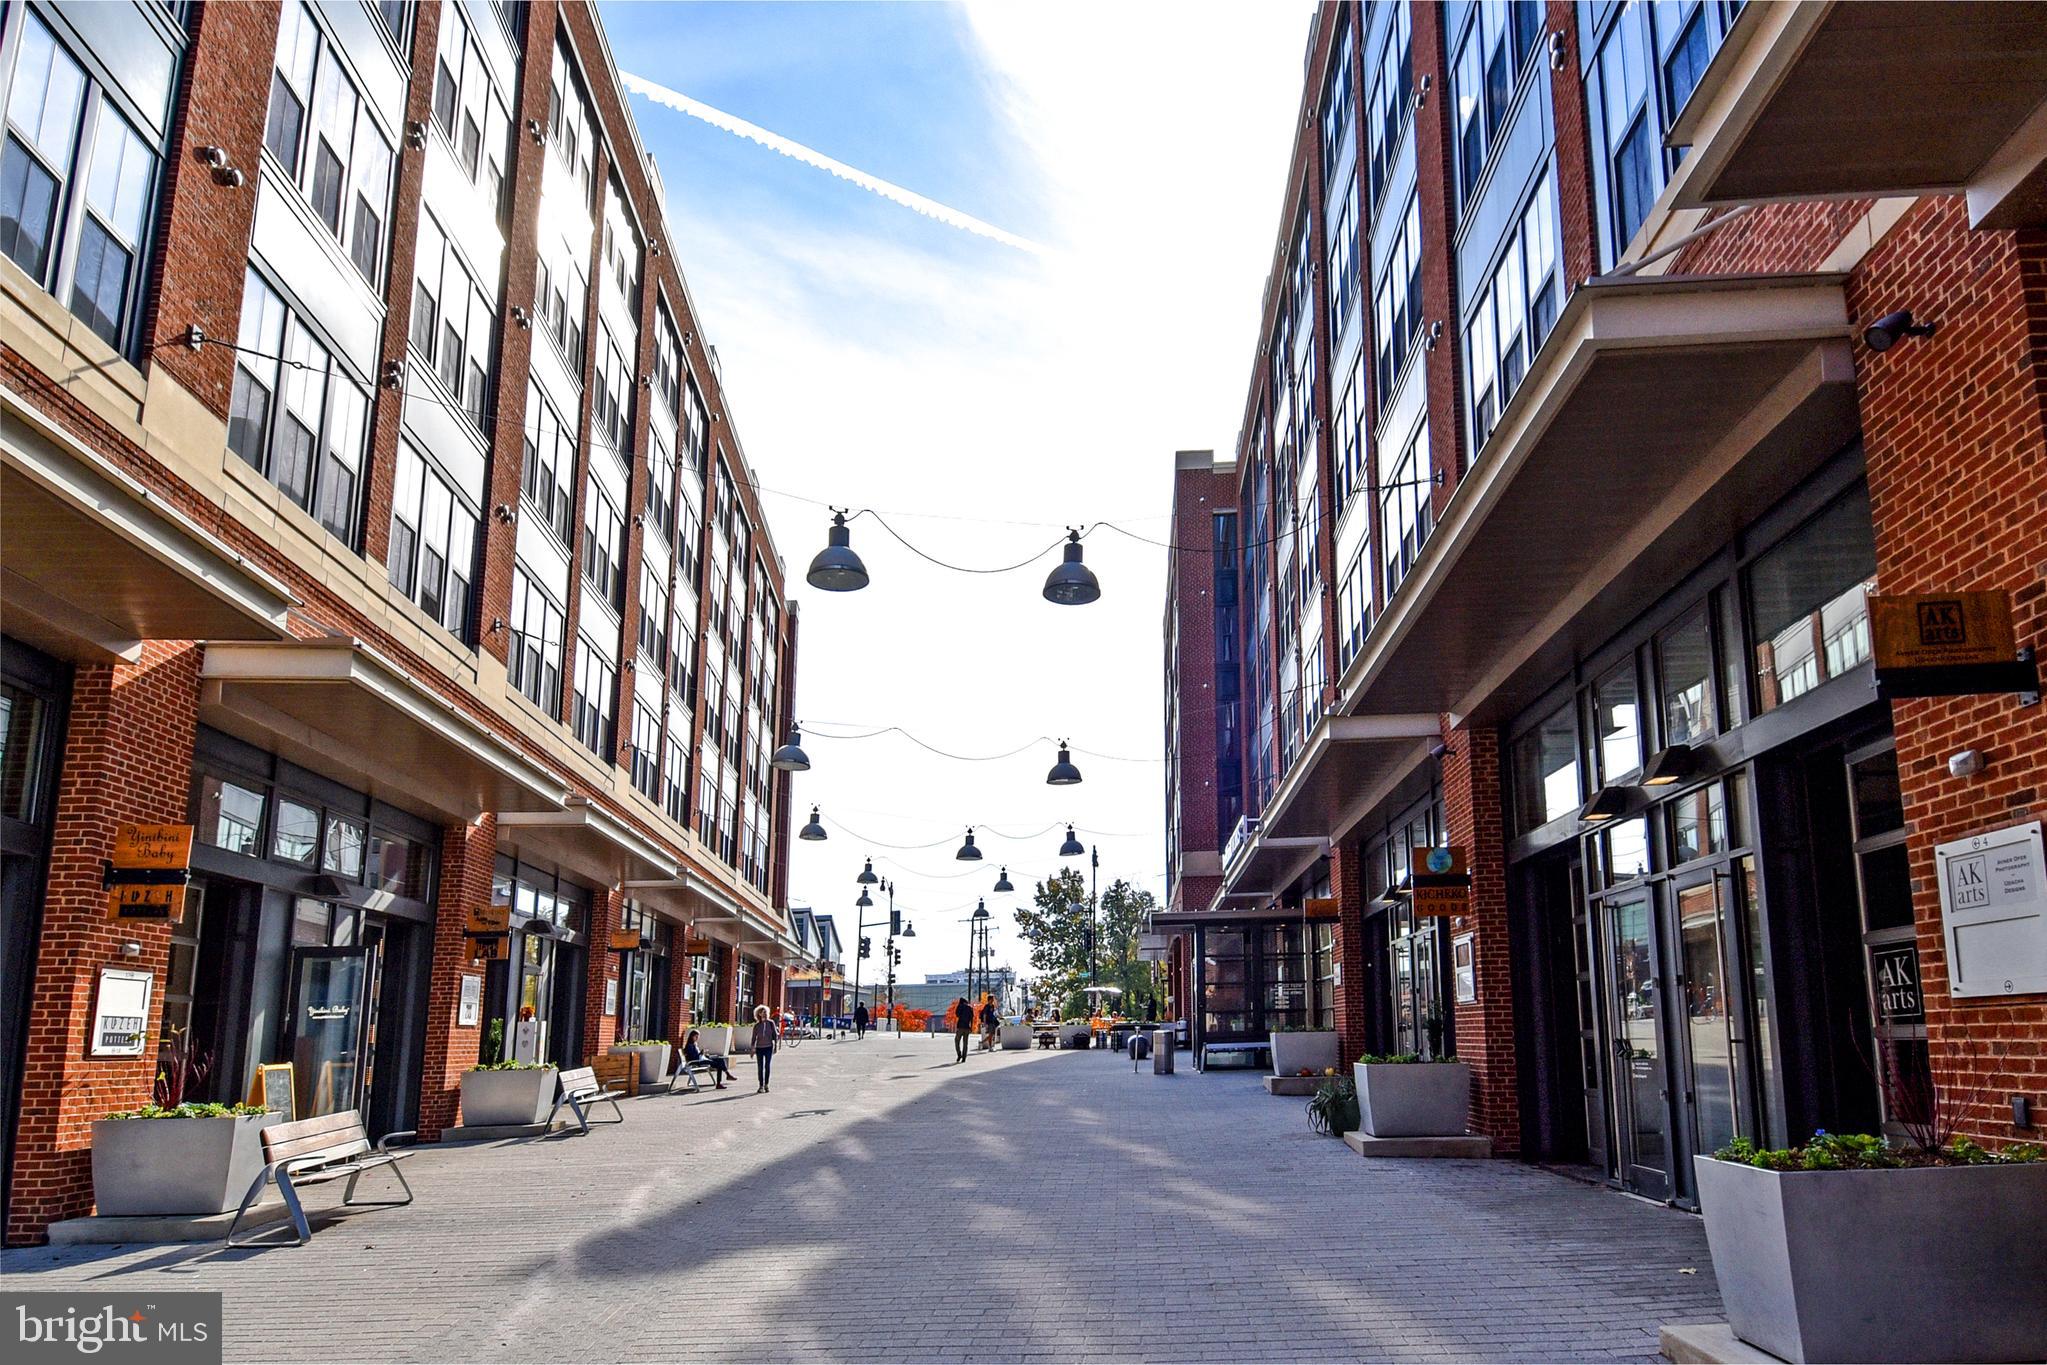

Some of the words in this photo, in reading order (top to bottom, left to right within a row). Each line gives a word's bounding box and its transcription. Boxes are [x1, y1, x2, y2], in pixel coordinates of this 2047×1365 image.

[1927, 606, 1957, 626] AK
[137, 842, 175, 864] Baby
[1957, 861, 1983, 888] AK
[1957, 886, 1985, 905] arts
[1881, 956, 1913, 988] AK
[1882, 988, 1915, 1010] arts
[103, 1016, 139, 1030] KUZEH
[105, 1034, 133, 1045] POTTE
